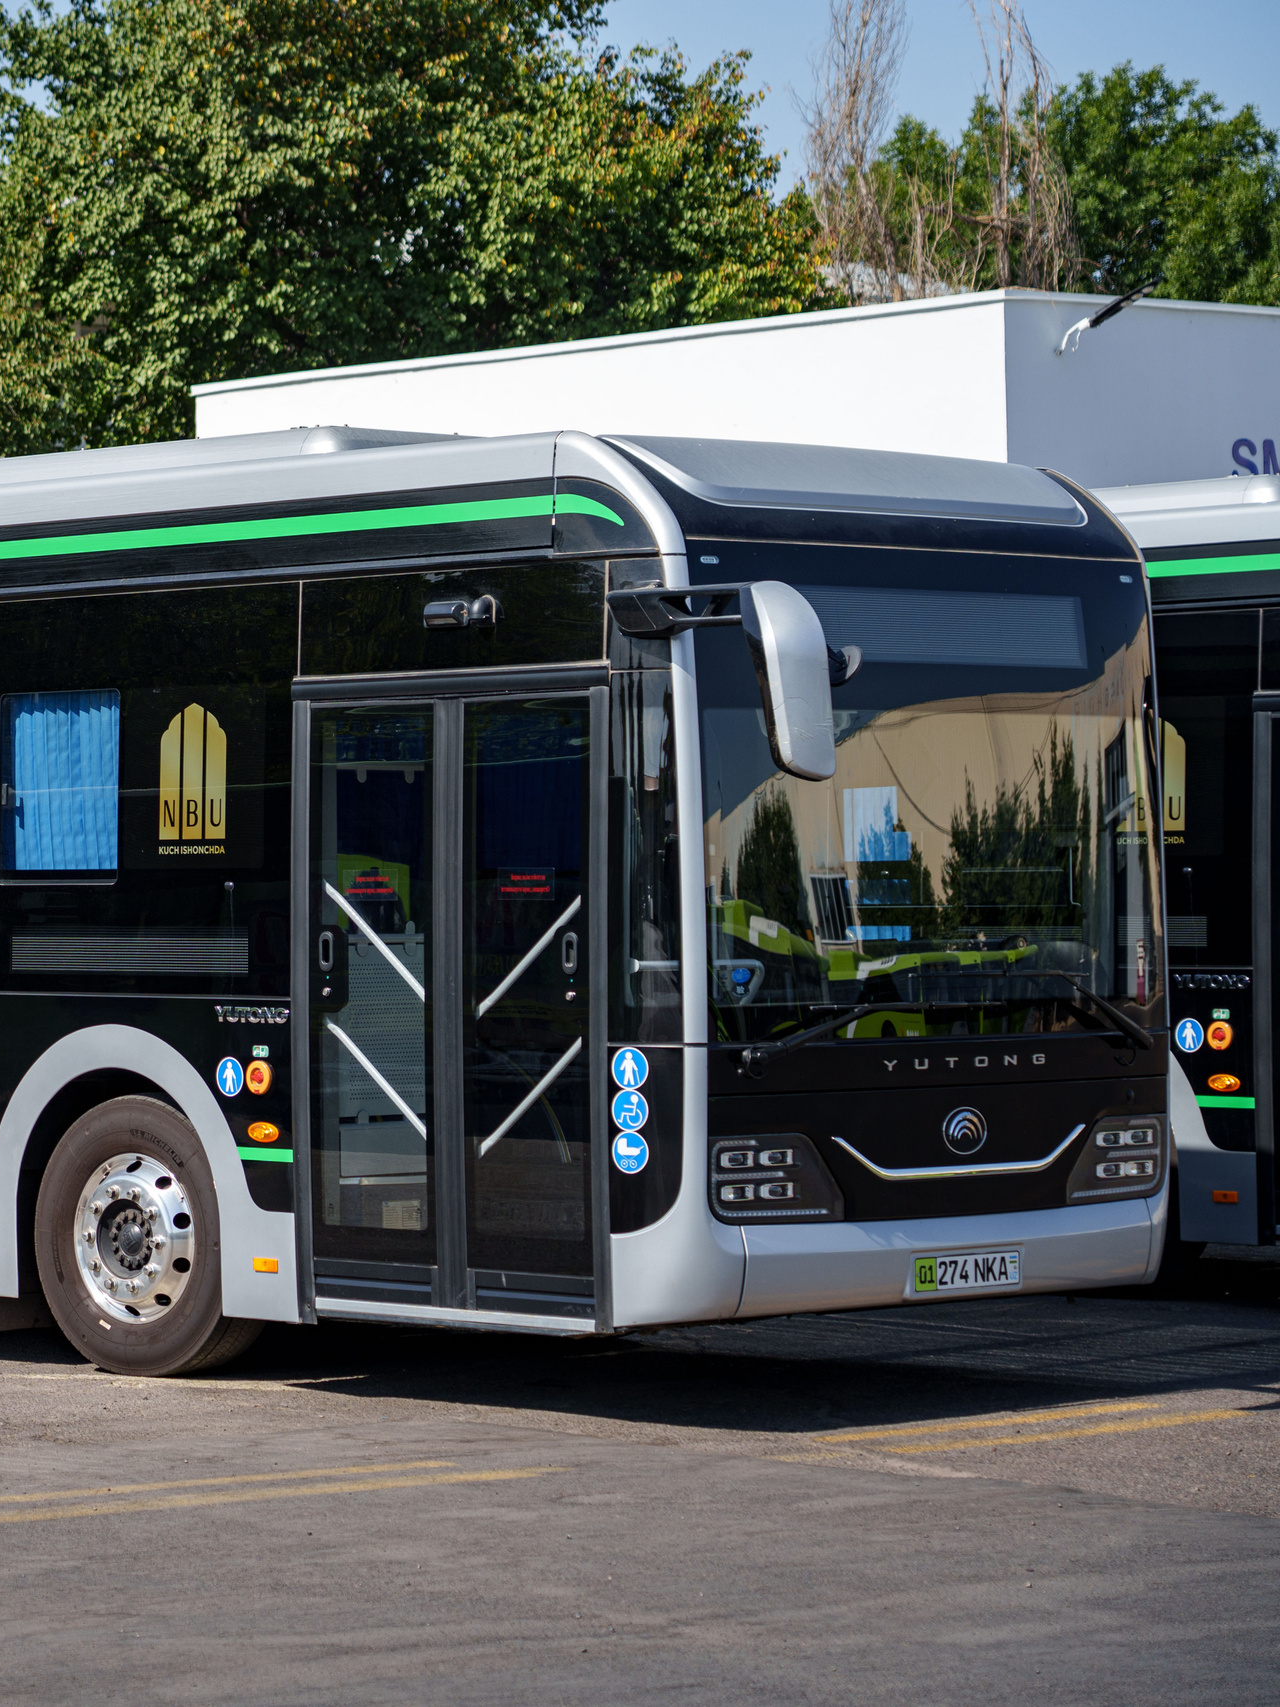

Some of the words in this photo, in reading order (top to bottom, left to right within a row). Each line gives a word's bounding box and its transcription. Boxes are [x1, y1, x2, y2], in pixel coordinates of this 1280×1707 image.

[163, 798, 222, 828] NBU
[158, 845, 180, 855] KUCH
[180, 845, 226, 855] ISHONCHDA
[1173, 973, 1251, 990] YUTONG
[213, 1005, 290, 1024] YUTONG
[883, 1053, 1047, 1072] YUTONG
[143, 1133, 183, 1164] MICHELIN
[919, 1264, 935, 1285] 01
[938, 1259, 969, 1286] 274
[974, 1256, 1009, 1284] NKA
